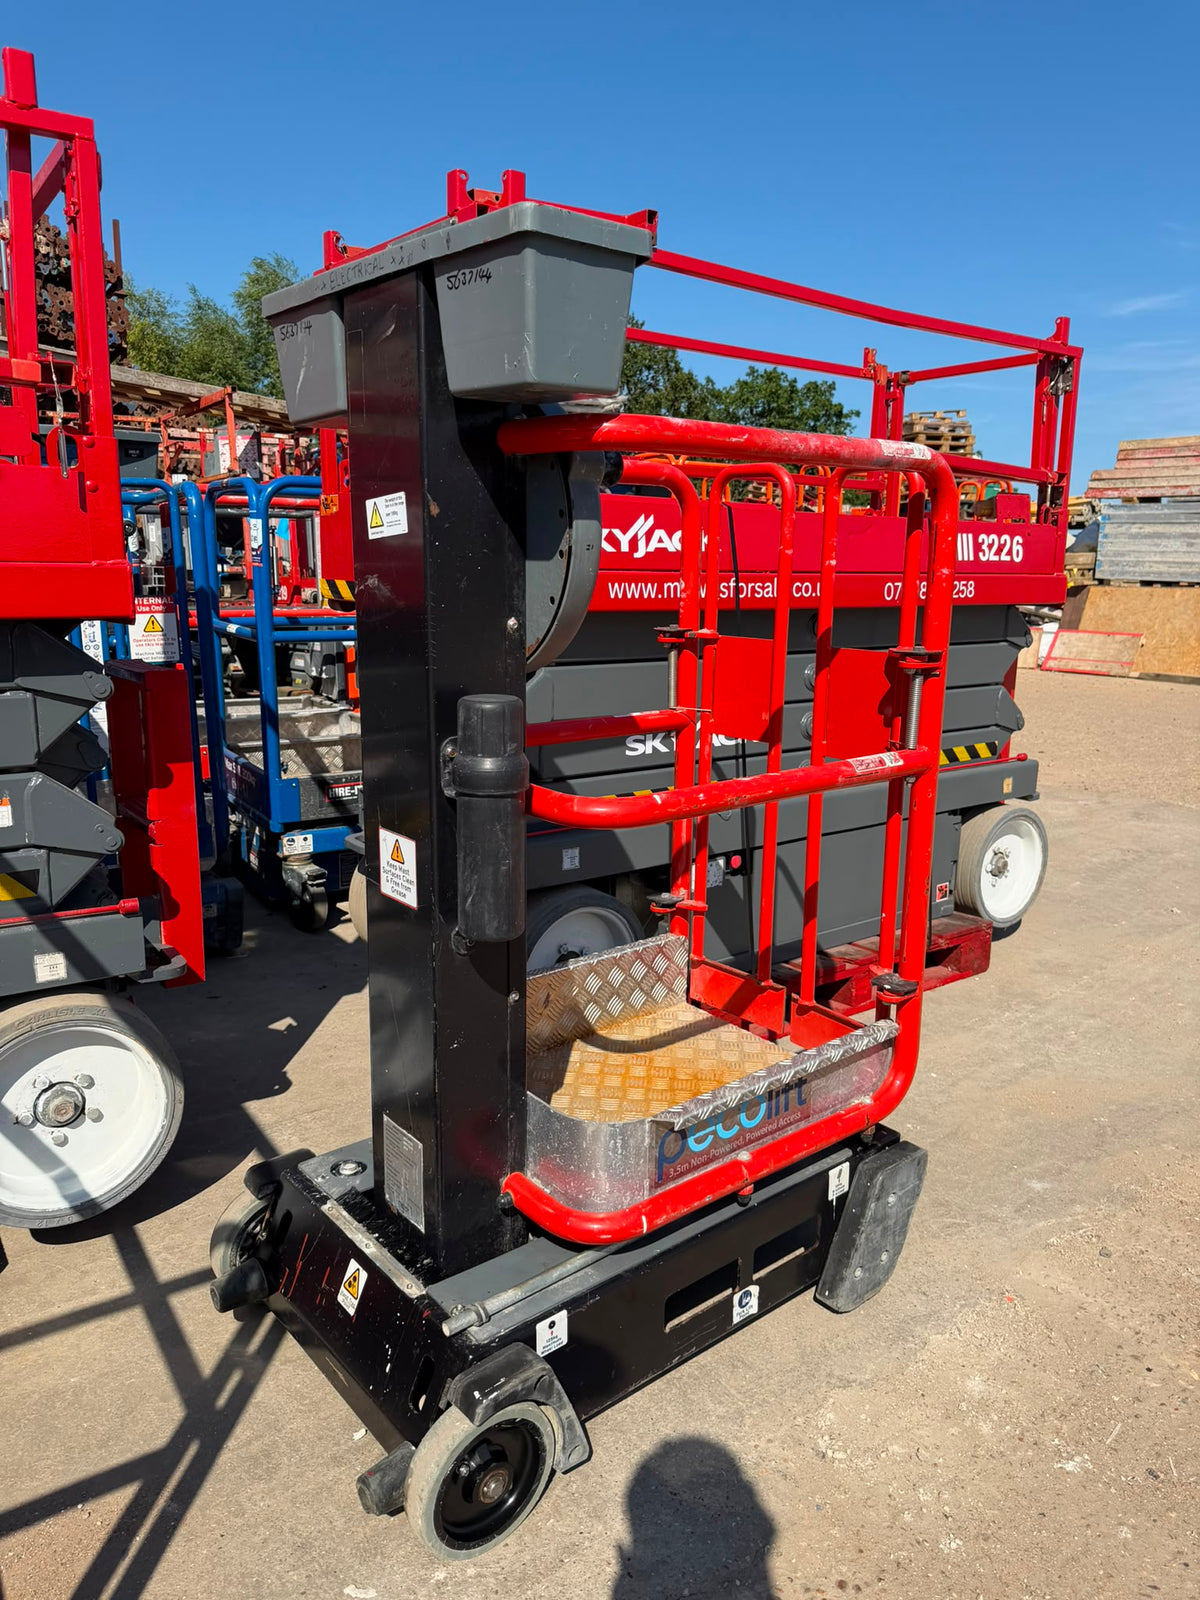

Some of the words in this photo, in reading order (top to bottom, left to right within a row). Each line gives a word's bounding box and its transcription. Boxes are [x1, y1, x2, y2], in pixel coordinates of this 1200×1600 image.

[978, 533, 1024, 562] 3226
[387, 861, 397, 871] Keep
[746, 1123, 777, 1143] Powered
[778, 1111, 801, 1130] Access
